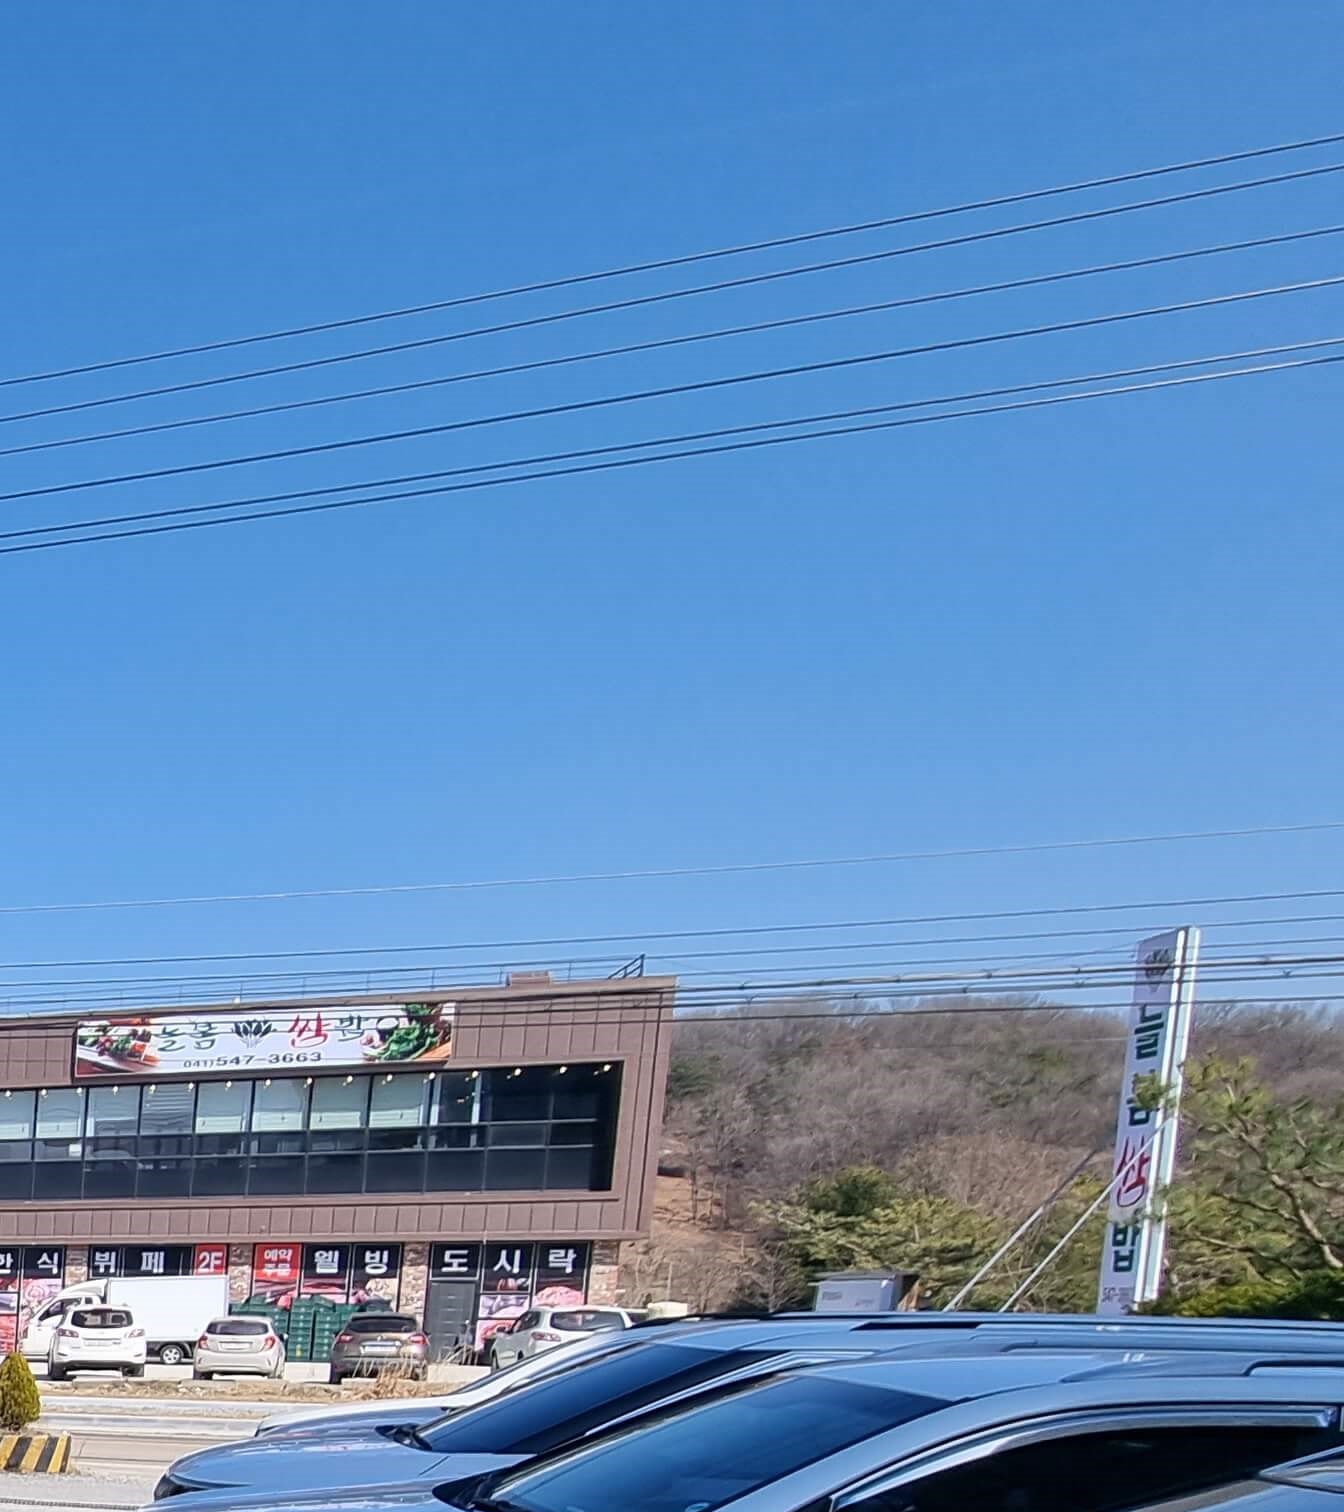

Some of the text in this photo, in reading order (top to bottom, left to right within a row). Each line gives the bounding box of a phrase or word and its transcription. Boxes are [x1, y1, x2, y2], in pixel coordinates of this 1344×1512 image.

[94, 1251, 165, 1274] 뷔페
[199, 1251, 224, 1273] 2F
[314, 1250, 389, 1274] 웰빙
[441, 1249, 577, 1274] 도시락
